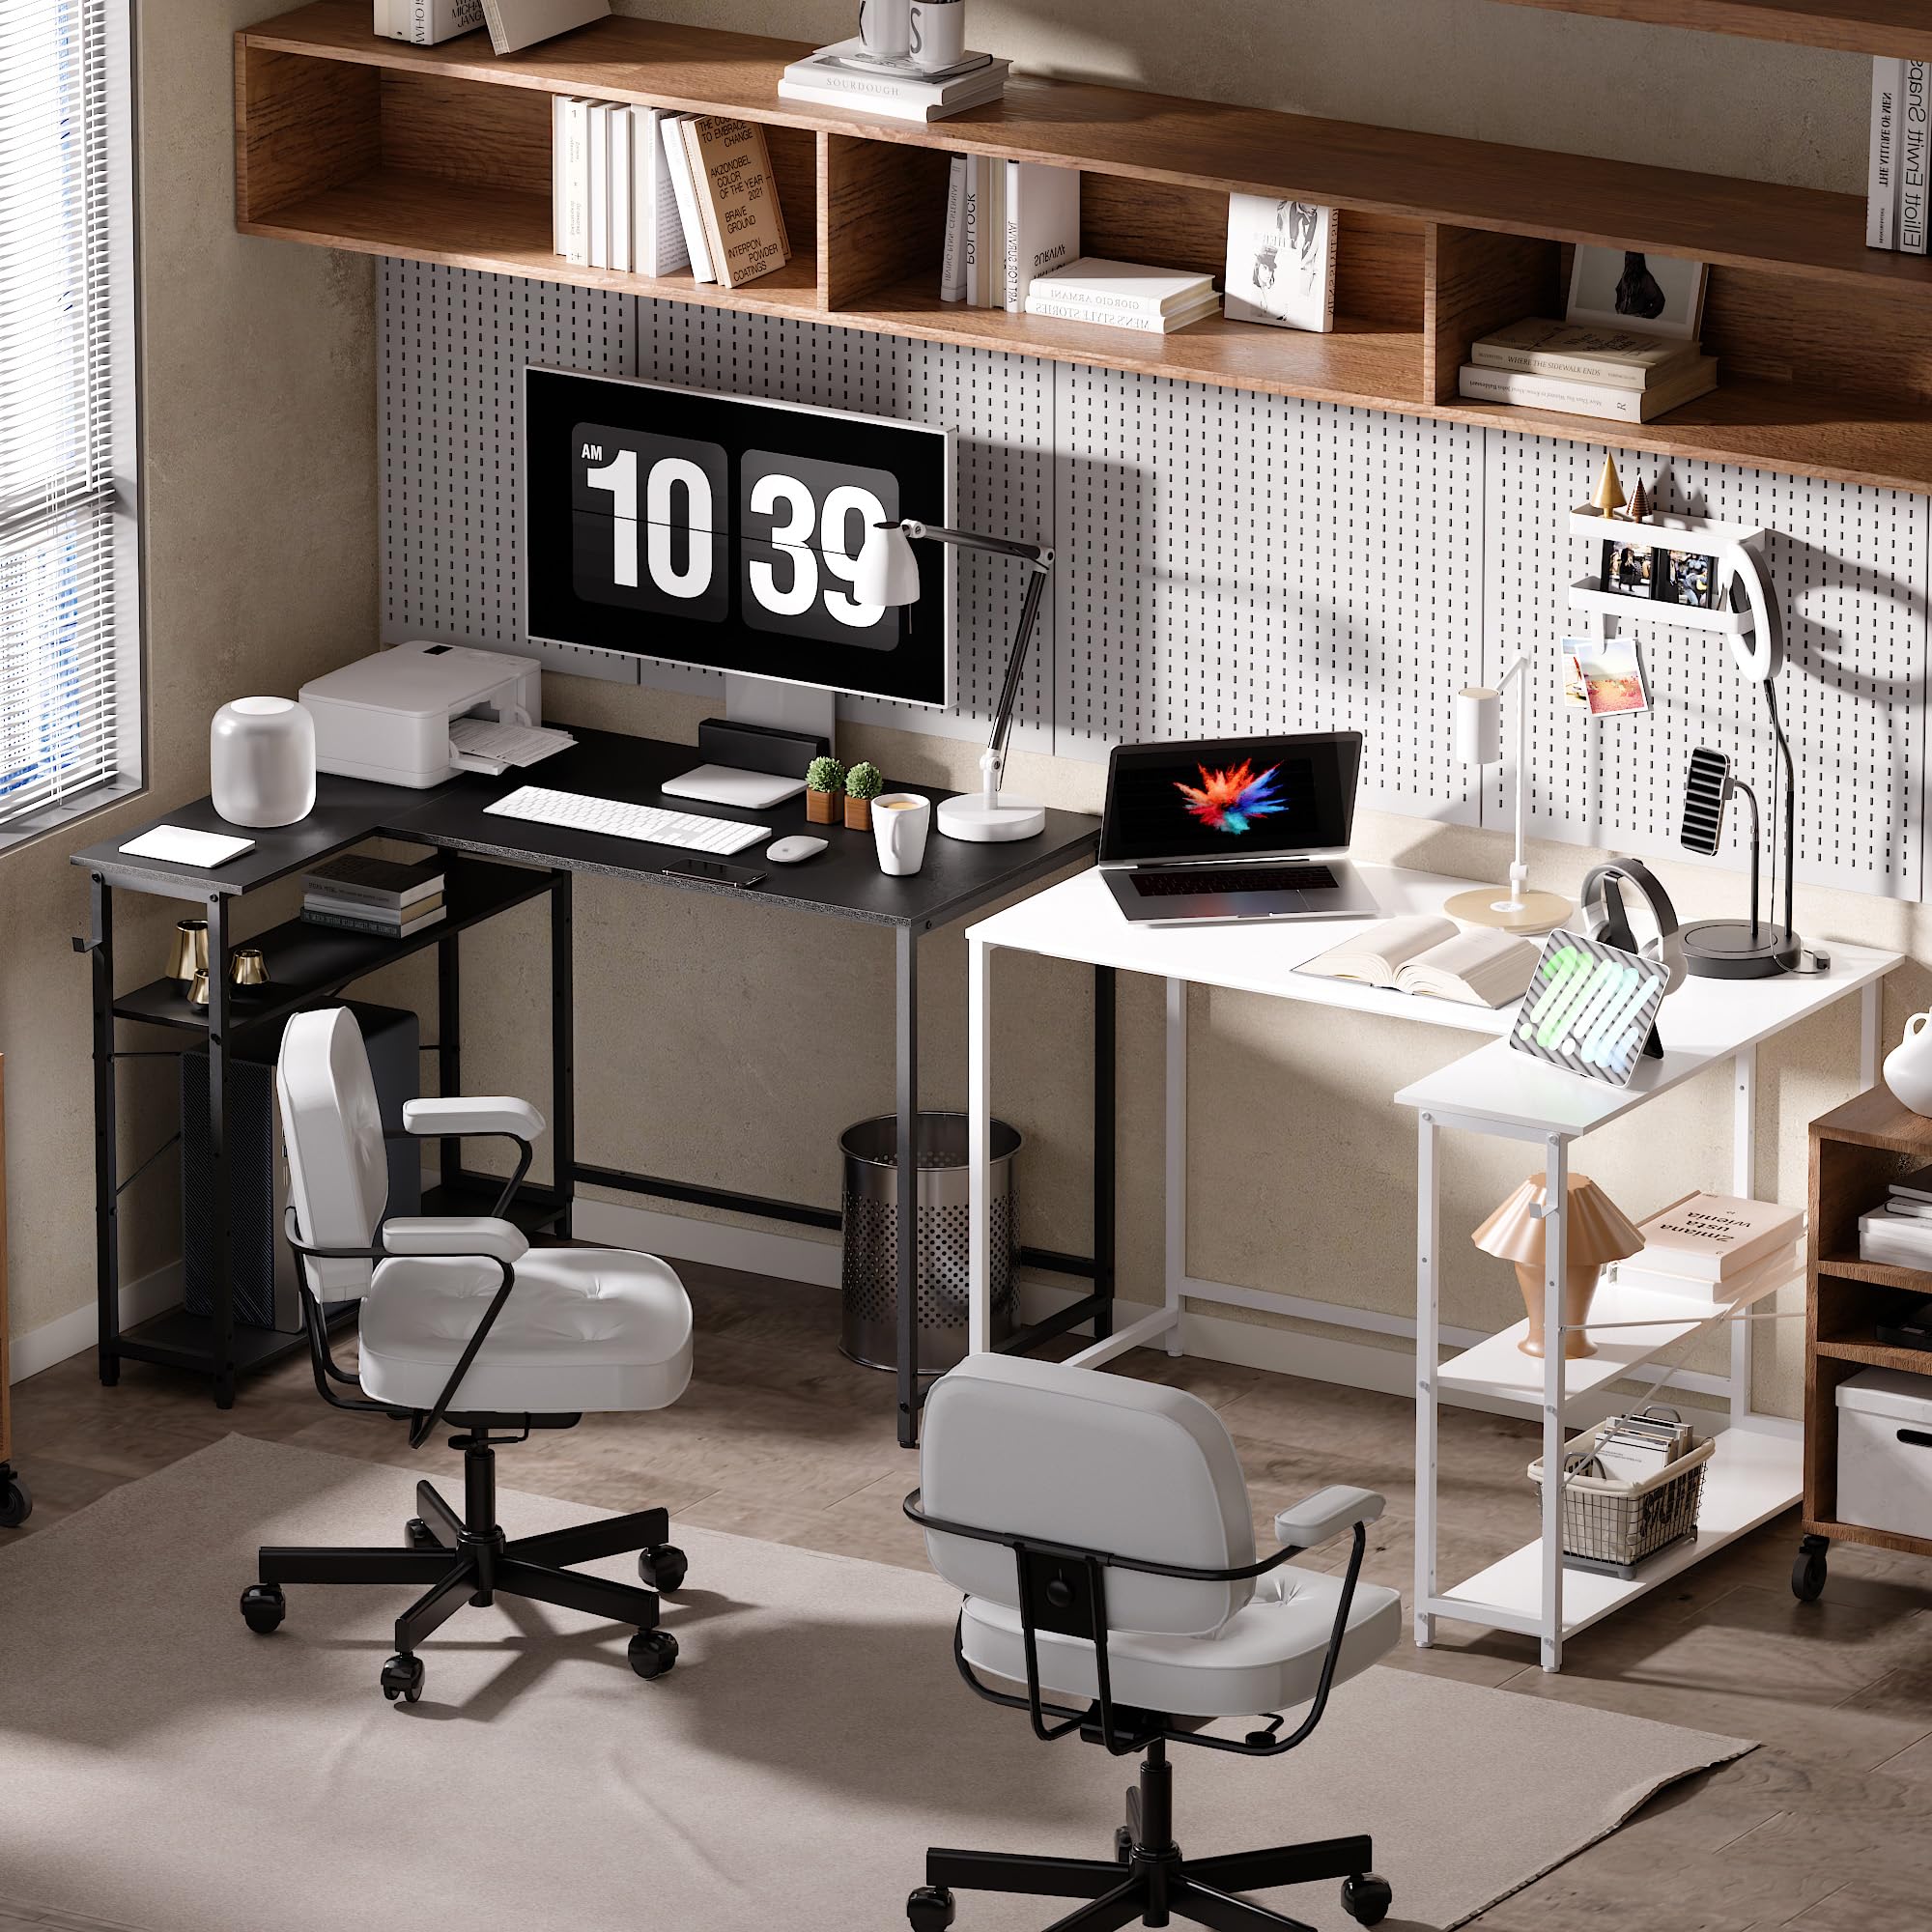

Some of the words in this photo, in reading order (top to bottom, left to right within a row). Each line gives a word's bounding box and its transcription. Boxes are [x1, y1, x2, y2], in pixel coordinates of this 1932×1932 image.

[452, 0, 484, 18] MICHA
[458, 10, 482, 27] JANG
[415, 8, 425, 43] WHO
[910, 7, 923, 54] S
[826, 76, 899, 96] SOURDOUGH
[699, 118, 713, 132] THE
[702, 131, 713, 143] TO
[715, 122, 747, 139] EMBRACE
[724, 128, 753, 147] CHANGE
[710, 155, 752, 178] AKZONOBEL
[717, 171, 741, 188] COLOR
[719, 187, 729, 200] OF
[730, 183, 744, 194] THE
[745, 174, 763, 188] YEAR
[749, 187, 763, 201] 2021
[724, 206, 748, 222] BRAVE
[727, 214, 756, 234] GROUND
[727, 237, 762, 259] INTERPON
[749, 243, 779, 263] POWDER
[734, 261, 767, 282] COATINGS
[1507, 355, 1532, 367] WHERE
[1533, 358, 1547, 369] THE
[1548, 361, 1582, 375] SIDEWALK
[1582, 365, 1601, 378] ENDS
[581, 442, 603, 462] AM
[586, 449, 713, 599] 10
[749, 472, 888, 629] 39
